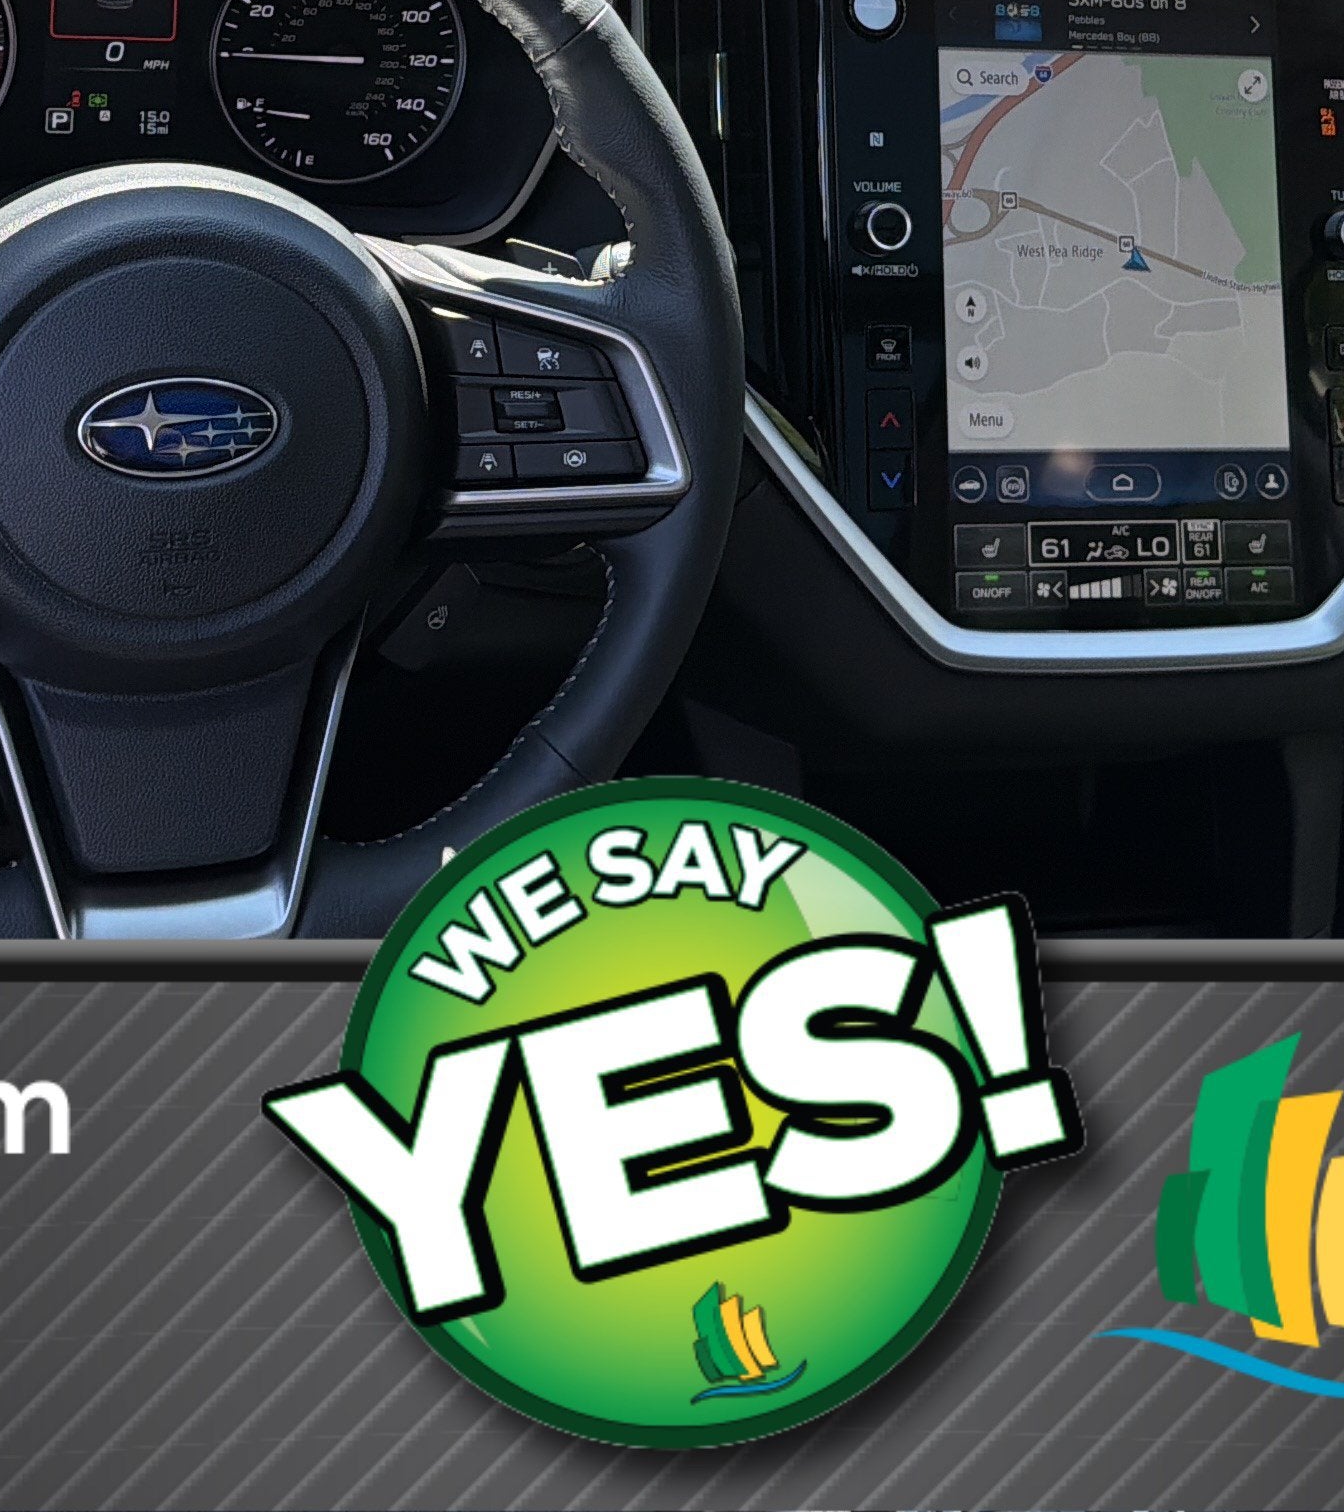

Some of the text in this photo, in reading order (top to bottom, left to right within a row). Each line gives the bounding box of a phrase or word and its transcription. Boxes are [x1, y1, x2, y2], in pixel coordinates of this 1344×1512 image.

[249, 4, 275, 18] 20
[401, 10, 431, 23] 100
[1068, 14, 1105, 26] Pebbles
[1068, 30, 1114, 42] Mercedes
[1117, 31, 1136, 44] Boy
[105, 41, 170, 70] 0 MPH
[408, 54, 438, 67] 120
[980, 69, 1019, 86] Search
[396, 98, 425, 111] 140
[51, 112, 68, 129] P
[139, 110, 171, 123] 15.0
[362, 133, 393, 146] 160
[305, 155, 315, 165] E
[854, 181, 902, 193] VOLUME
[1017, 244, 1104, 260] West Pea Ridge
[967, 309, 975, 317] N
[875, 353, 902, 361] FRONT
[969, 412, 1004, 428] Menu
[1112, 524, 1131, 537] A/C
[1188, 532, 1214, 542] REAR
[1041, 536, 1170, 559] 61 LO
[1193, 542, 1211, 557] 61
[1190, 576, 1217, 587] REAR
[1250, 581, 1269, 594] A/C
[972, 587, 1012, 599] ON/OFF
[1185, 588, 1223, 600] ON/OFF
